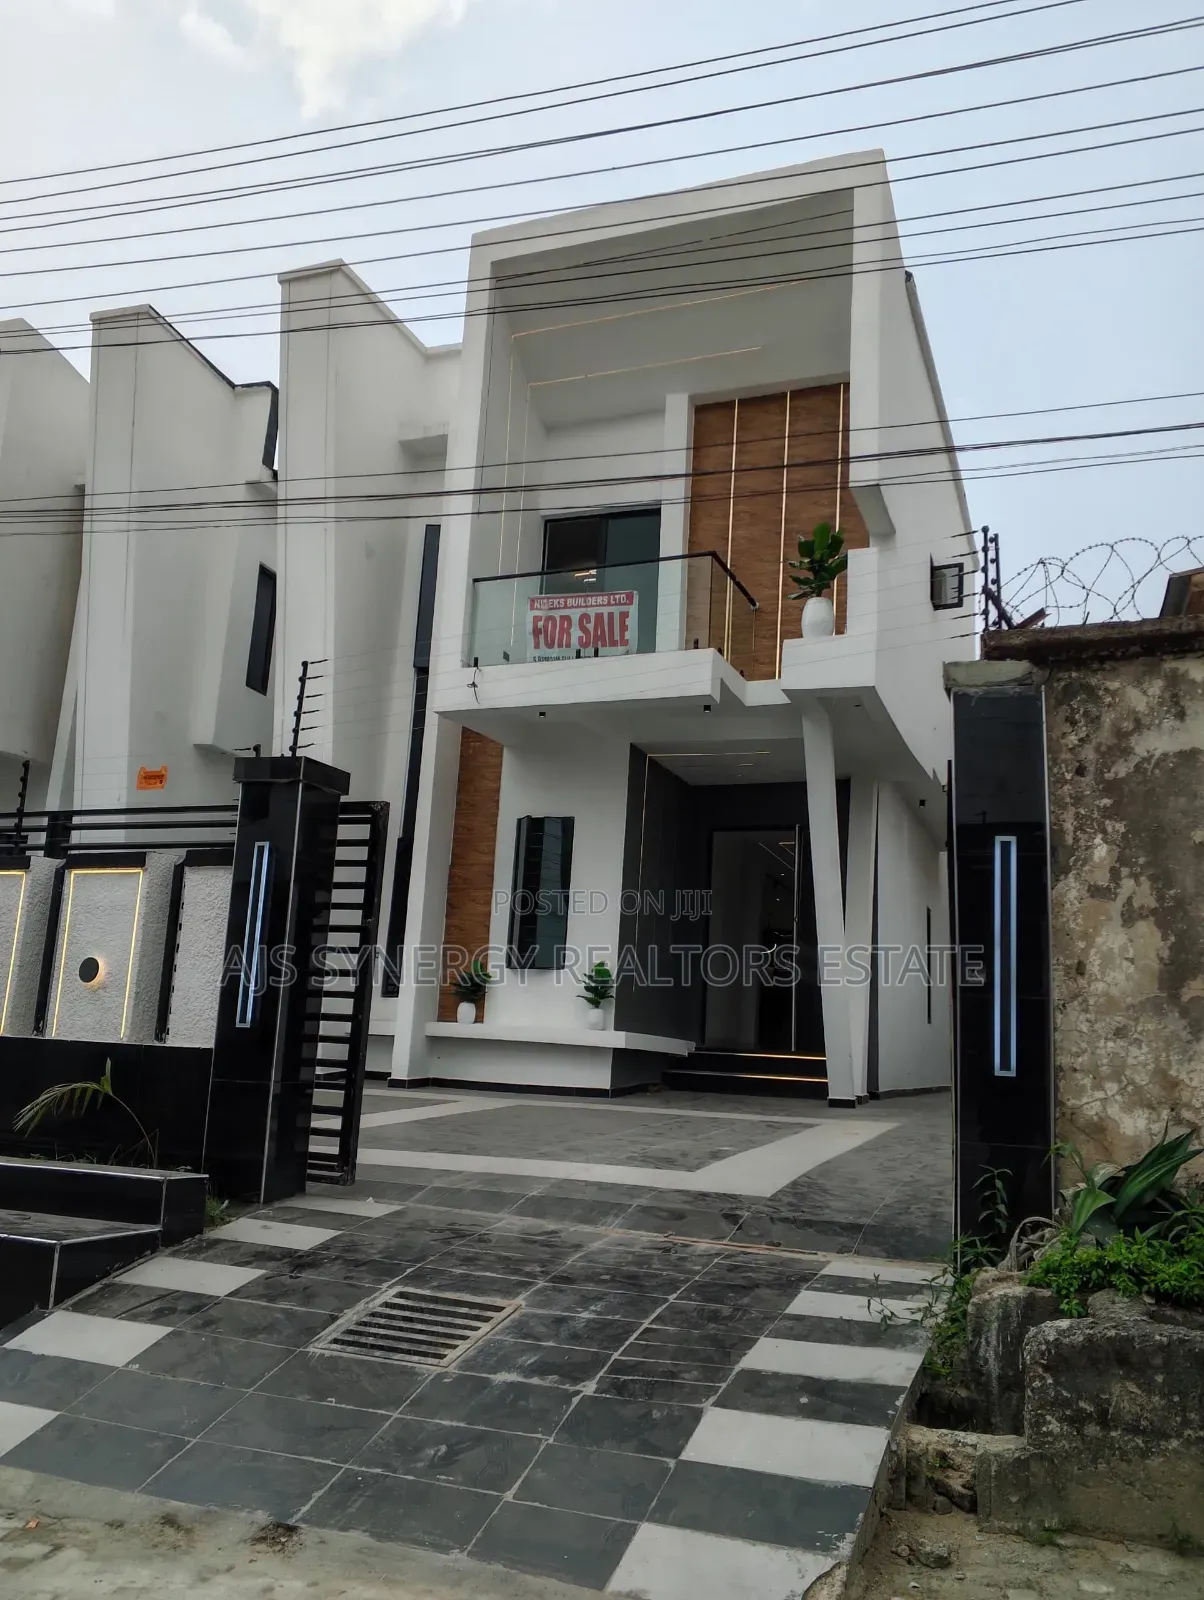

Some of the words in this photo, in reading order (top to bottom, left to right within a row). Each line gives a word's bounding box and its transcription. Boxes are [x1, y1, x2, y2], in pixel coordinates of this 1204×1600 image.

[566, 596, 608, 607] BUILDERS
[610, 594, 629, 605] LTD.
[532, 615, 573, 649] FOR
[577, 611, 630, 648] SALE
